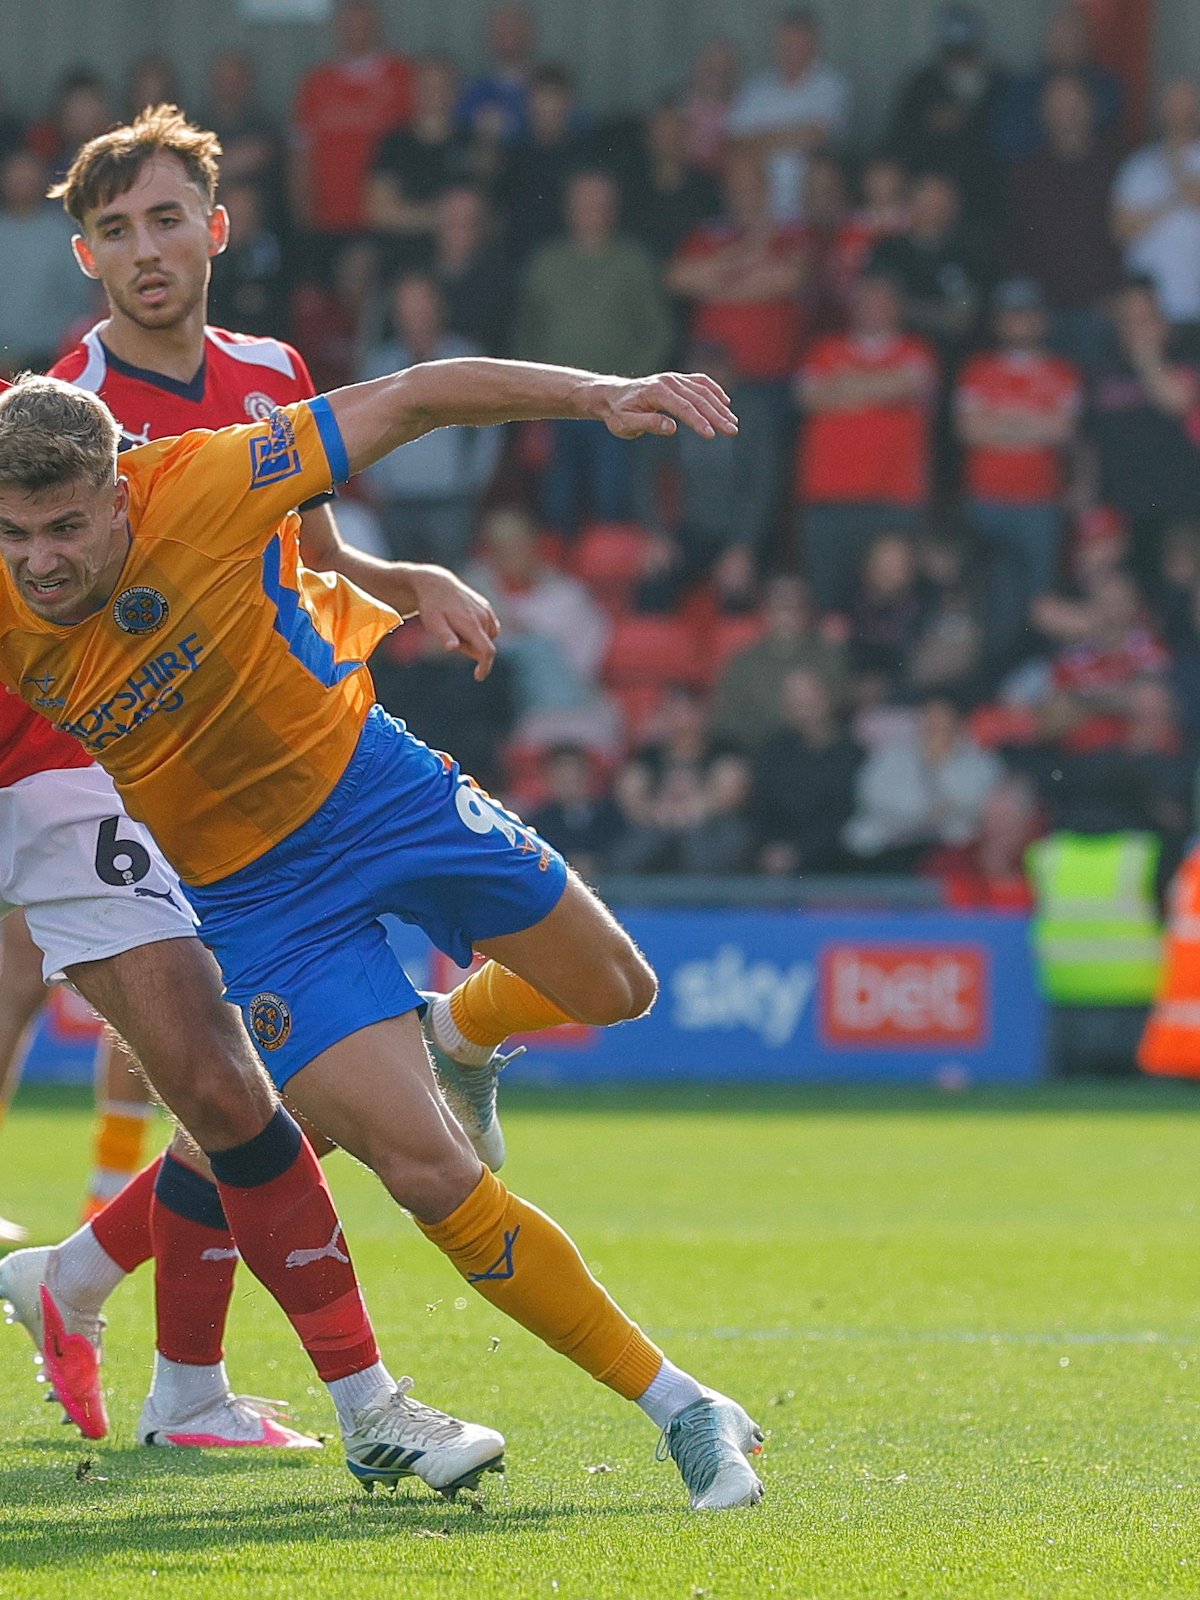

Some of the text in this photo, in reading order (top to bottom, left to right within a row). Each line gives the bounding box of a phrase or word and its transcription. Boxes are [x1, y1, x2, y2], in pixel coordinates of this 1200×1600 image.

[95, 815, 150, 886] 6
[455, 784, 516, 848] 9
[671, 943, 968, 1047] sky bet
